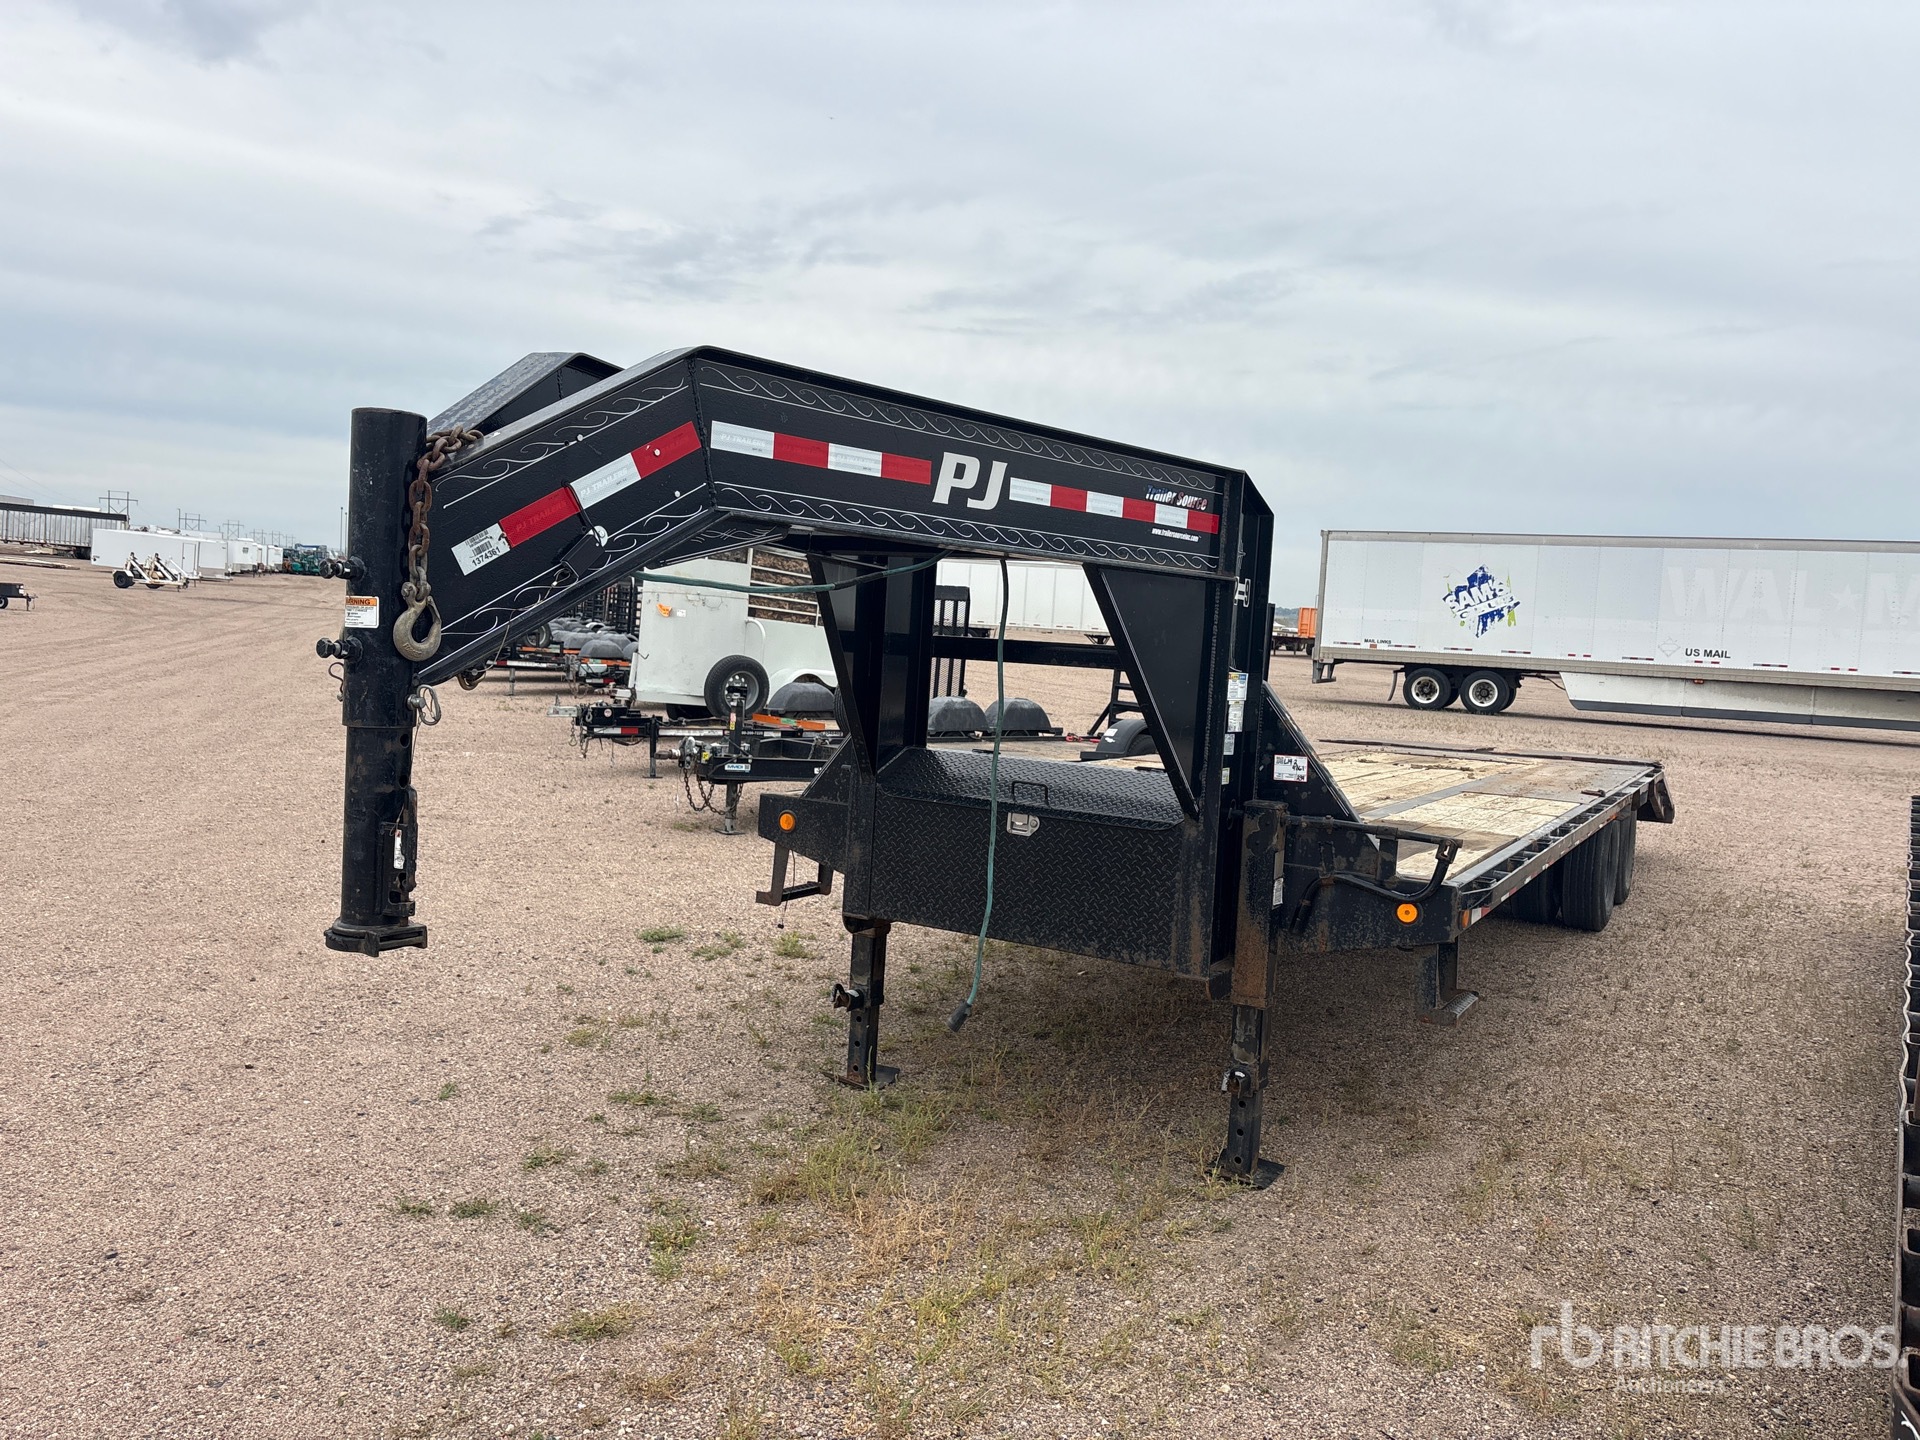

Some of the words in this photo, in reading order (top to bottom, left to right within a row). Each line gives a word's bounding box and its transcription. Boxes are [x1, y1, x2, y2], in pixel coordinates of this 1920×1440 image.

[932, 451, 1008, 511] PJ
[1145, 484, 1177, 504] Trailer
[1176, 491, 1208, 511] Source
[471, 546, 501, 567] 1374361
[1684, 647, 1701, 658] US
[1703, 649, 1731, 659] MAIL
